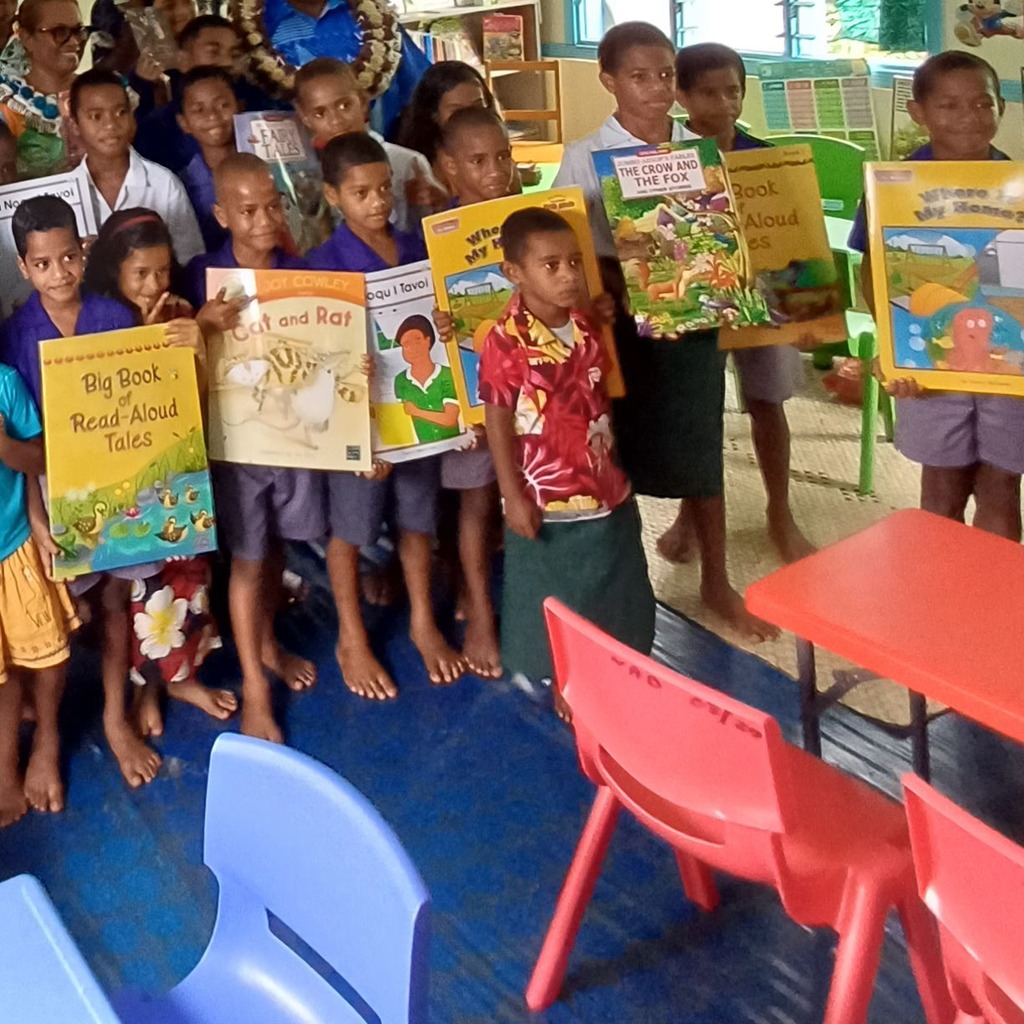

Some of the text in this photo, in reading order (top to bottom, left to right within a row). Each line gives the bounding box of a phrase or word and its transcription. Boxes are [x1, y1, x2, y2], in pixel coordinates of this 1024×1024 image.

[618, 159, 698, 177] THE CROW AND
[634, 172, 690, 187] THE FOX
[744, 208, 799, 230] Aloud
[465, 245, 488, 266] My
[292, 275, 350, 290] COWLEY
[366, 289, 391, 301] oqu
[399, 277, 429, 294] Tavoi
[232, 305, 353, 342] Cat and Rat
[81, 363, 162, 400] Big Book
[118, 391, 133, 408] of
[69, 397, 179, 434] Read-Aloud
[104, 431, 153, 453] Tales
